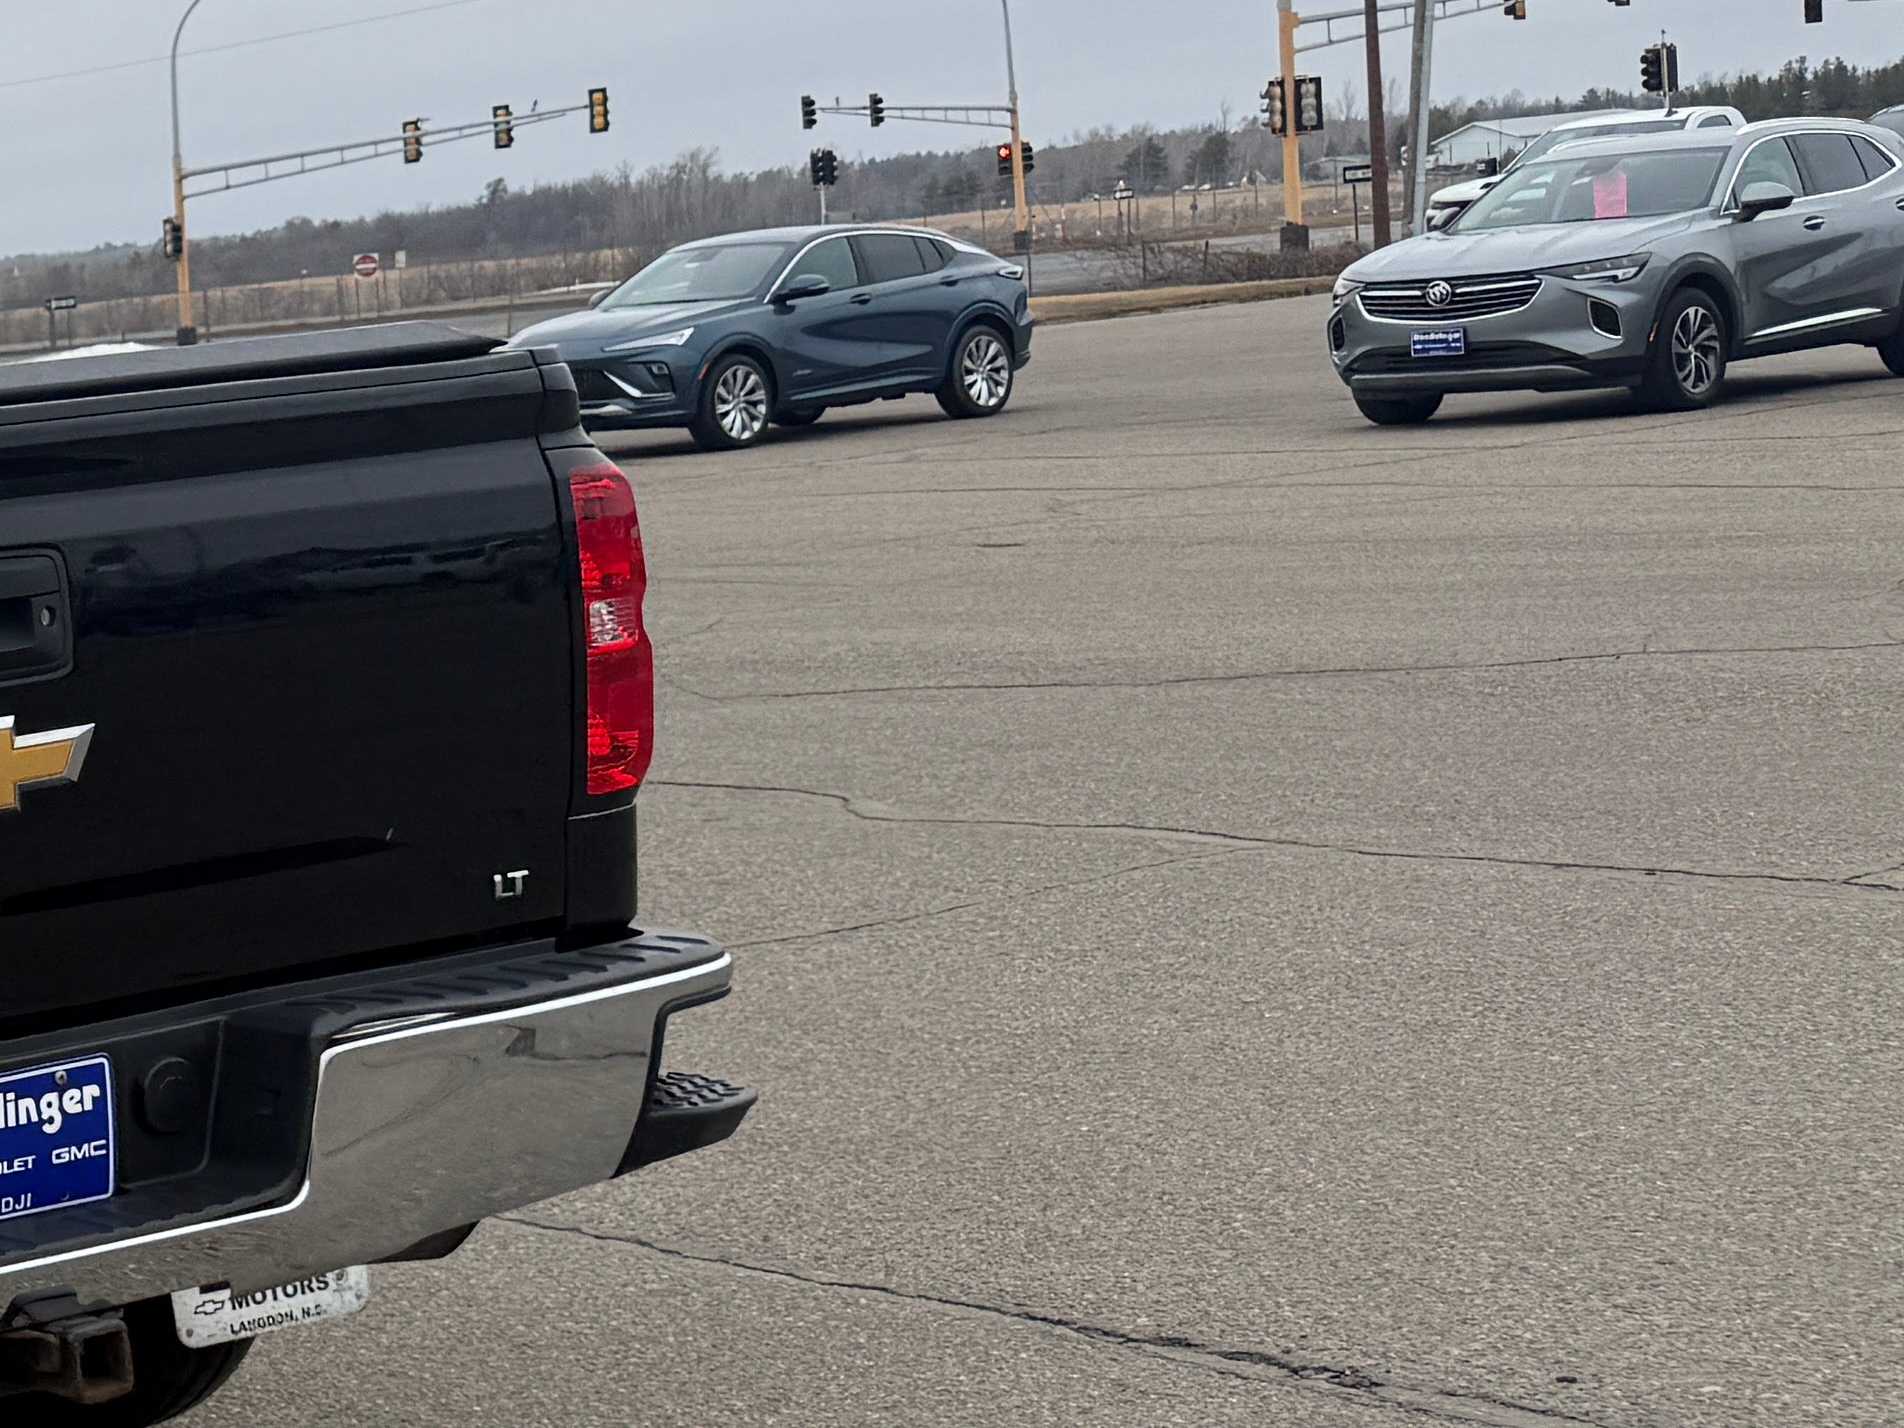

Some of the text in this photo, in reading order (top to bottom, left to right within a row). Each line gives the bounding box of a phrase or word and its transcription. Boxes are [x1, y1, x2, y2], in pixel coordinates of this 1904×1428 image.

[493, 869, 530, 899] LT
[51, 1139, 108, 1164] GMC
[229, 1273, 330, 1310] MOTORS
